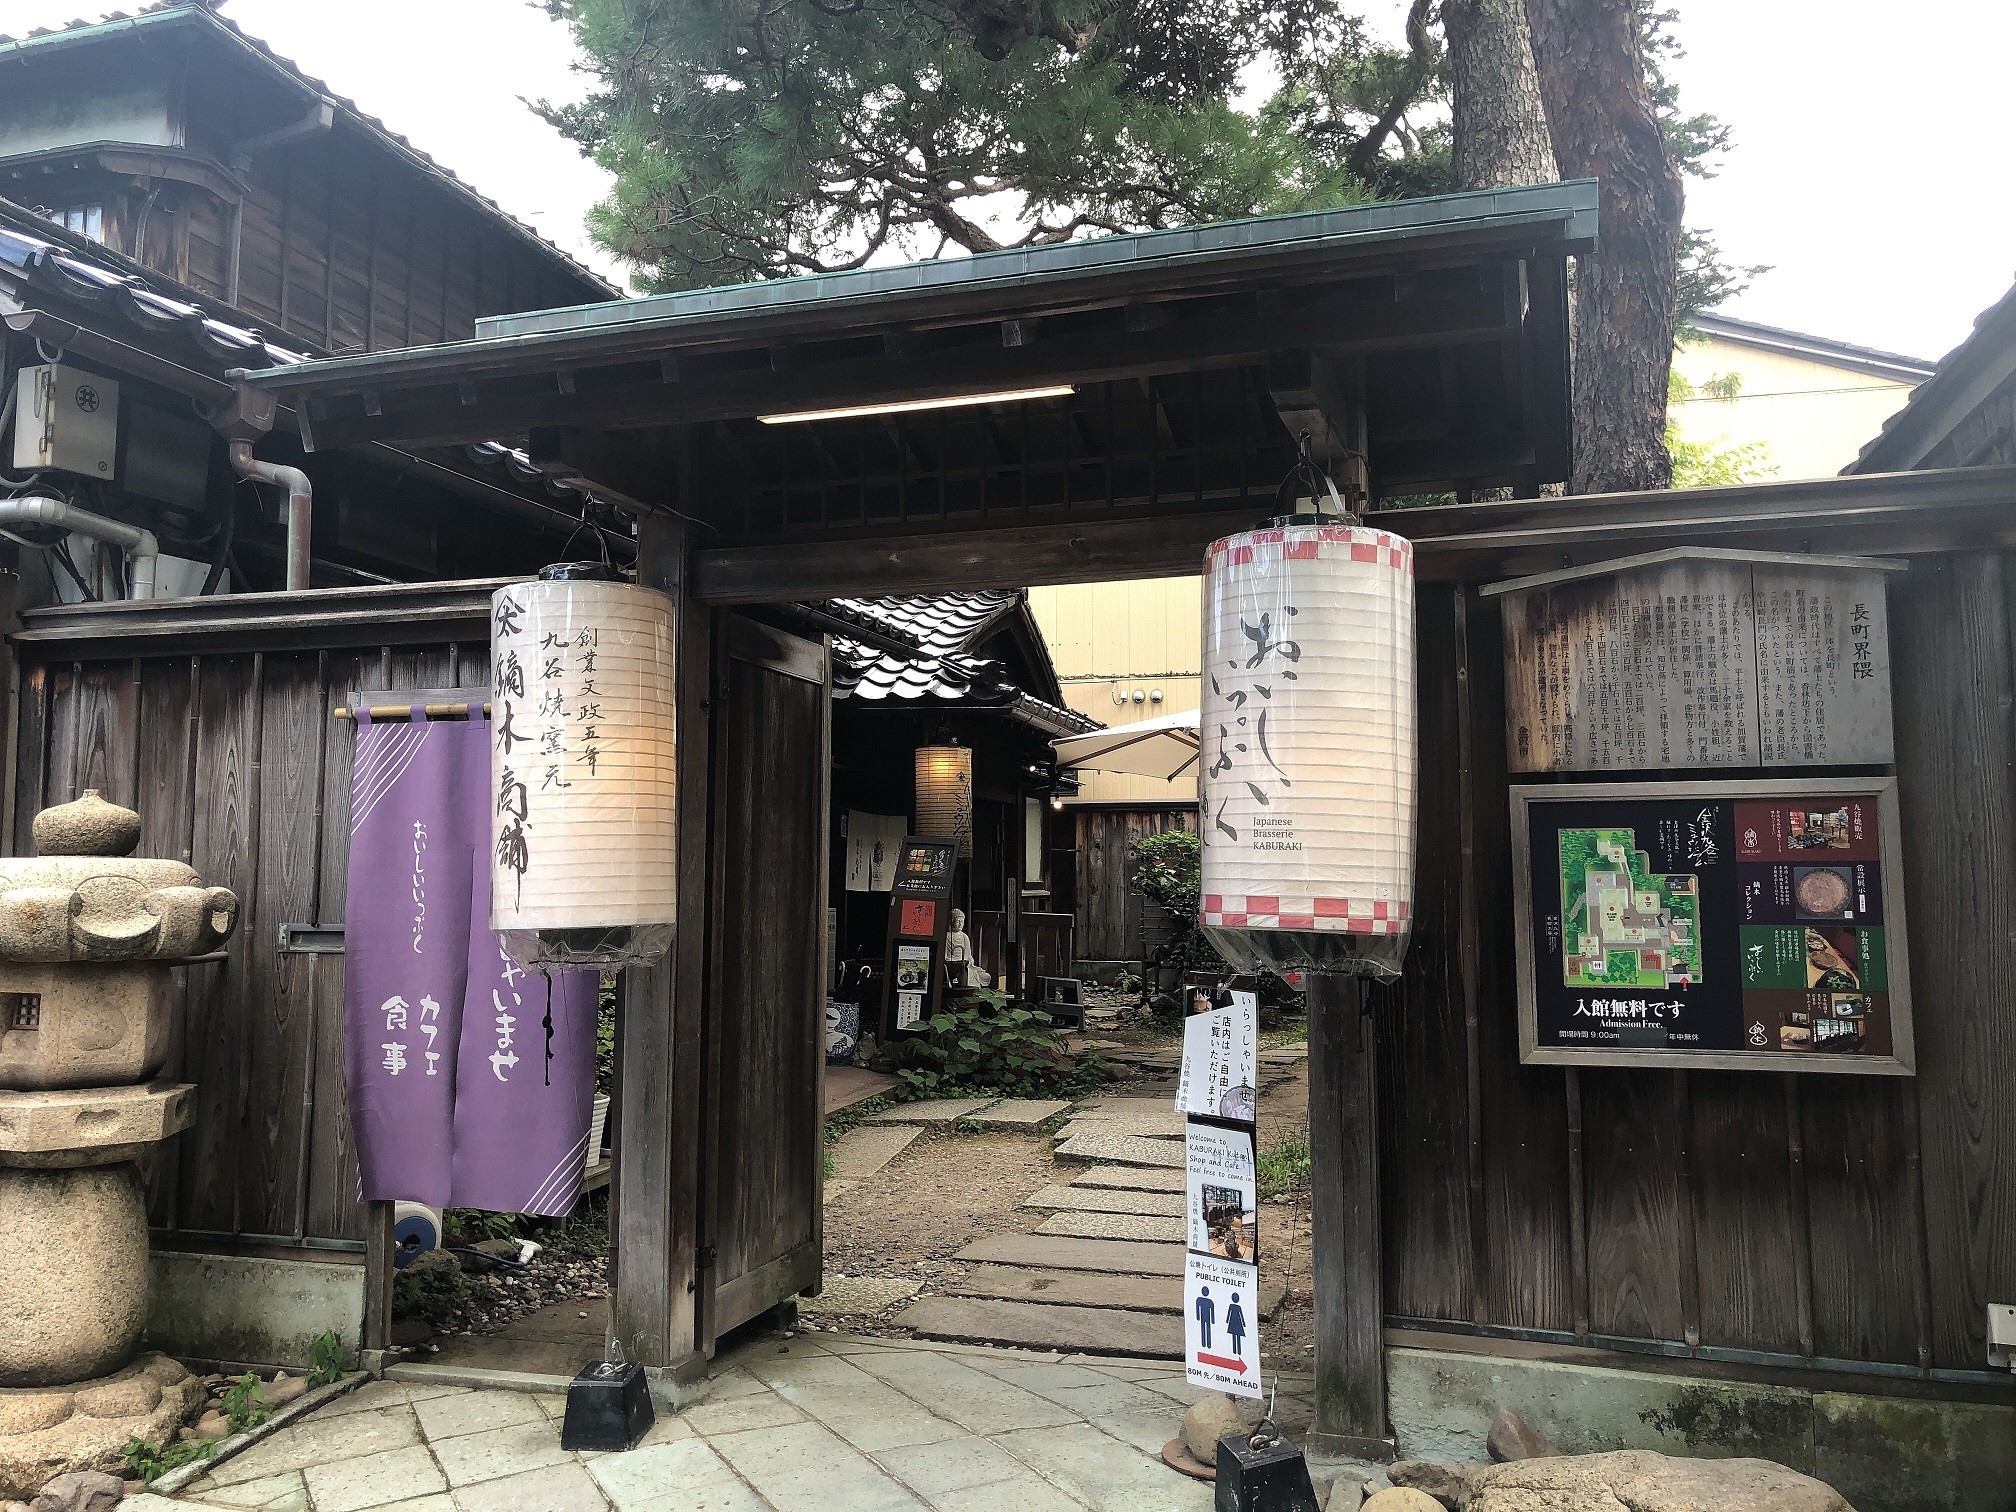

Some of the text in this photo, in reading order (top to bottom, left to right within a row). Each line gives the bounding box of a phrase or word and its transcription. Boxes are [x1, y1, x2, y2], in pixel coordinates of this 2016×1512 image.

[1850, 603, 1874, 680] 長町界隈
[539, 631, 572, 789] 九谷焼窯元
[573, 626, 606, 777] 創業文政五年
[1240, 606, 1301, 808] おいしい
[1518, 725, 1529, 757] 金沢市
[1252, 816, 1293, 828] Japanese
[1253, 828, 1294, 838] Brasserie
[1854, 803, 1863, 840] 九谷焼販売
[1253, 841, 1302, 852] KABURAKI
[412, 820, 427, 954] おいしいいっぷく
[1753, 881, 1761, 896] 鏑木
[1856, 864, 1866, 894] 常設展示
[1745, 885, 1753, 920] コレクション
[1860, 930, 1870, 960] お食事処
[1573, 999, 1685, 1019] 入館無料です
[1864, 996, 1873, 1013] カフェ
[380, 995, 409, 1077] 食事
[420, 994, 441, 1077] カフェ
[1590, 1031, 1620, 1040] 9:00am
[1669, 1033, 1699, 1041] 年中無休
[1600, 1019, 1663, 1029] Admission Free.
[1220, 1016, 1231, 1098] 店内はご自由に
[1240, 996, 1251, 1102] いらっしゃいませ
[1207, 1015, 1221, 1114] ご覧いただけます。
[1189, 1134, 1216, 1144] Welcome
[1189, 1144, 1225, 1156] KABURAKI
[1190, 1155, 1205, 1165] Shop
[1204, 1167, 1215, 1176] free
[1196, 1272, 1246, 1288] PUBLIC TOILET
[1188, 1368, 1202, 1377] 80M
[1233, 1377, 1258, 1390] AHEAD
